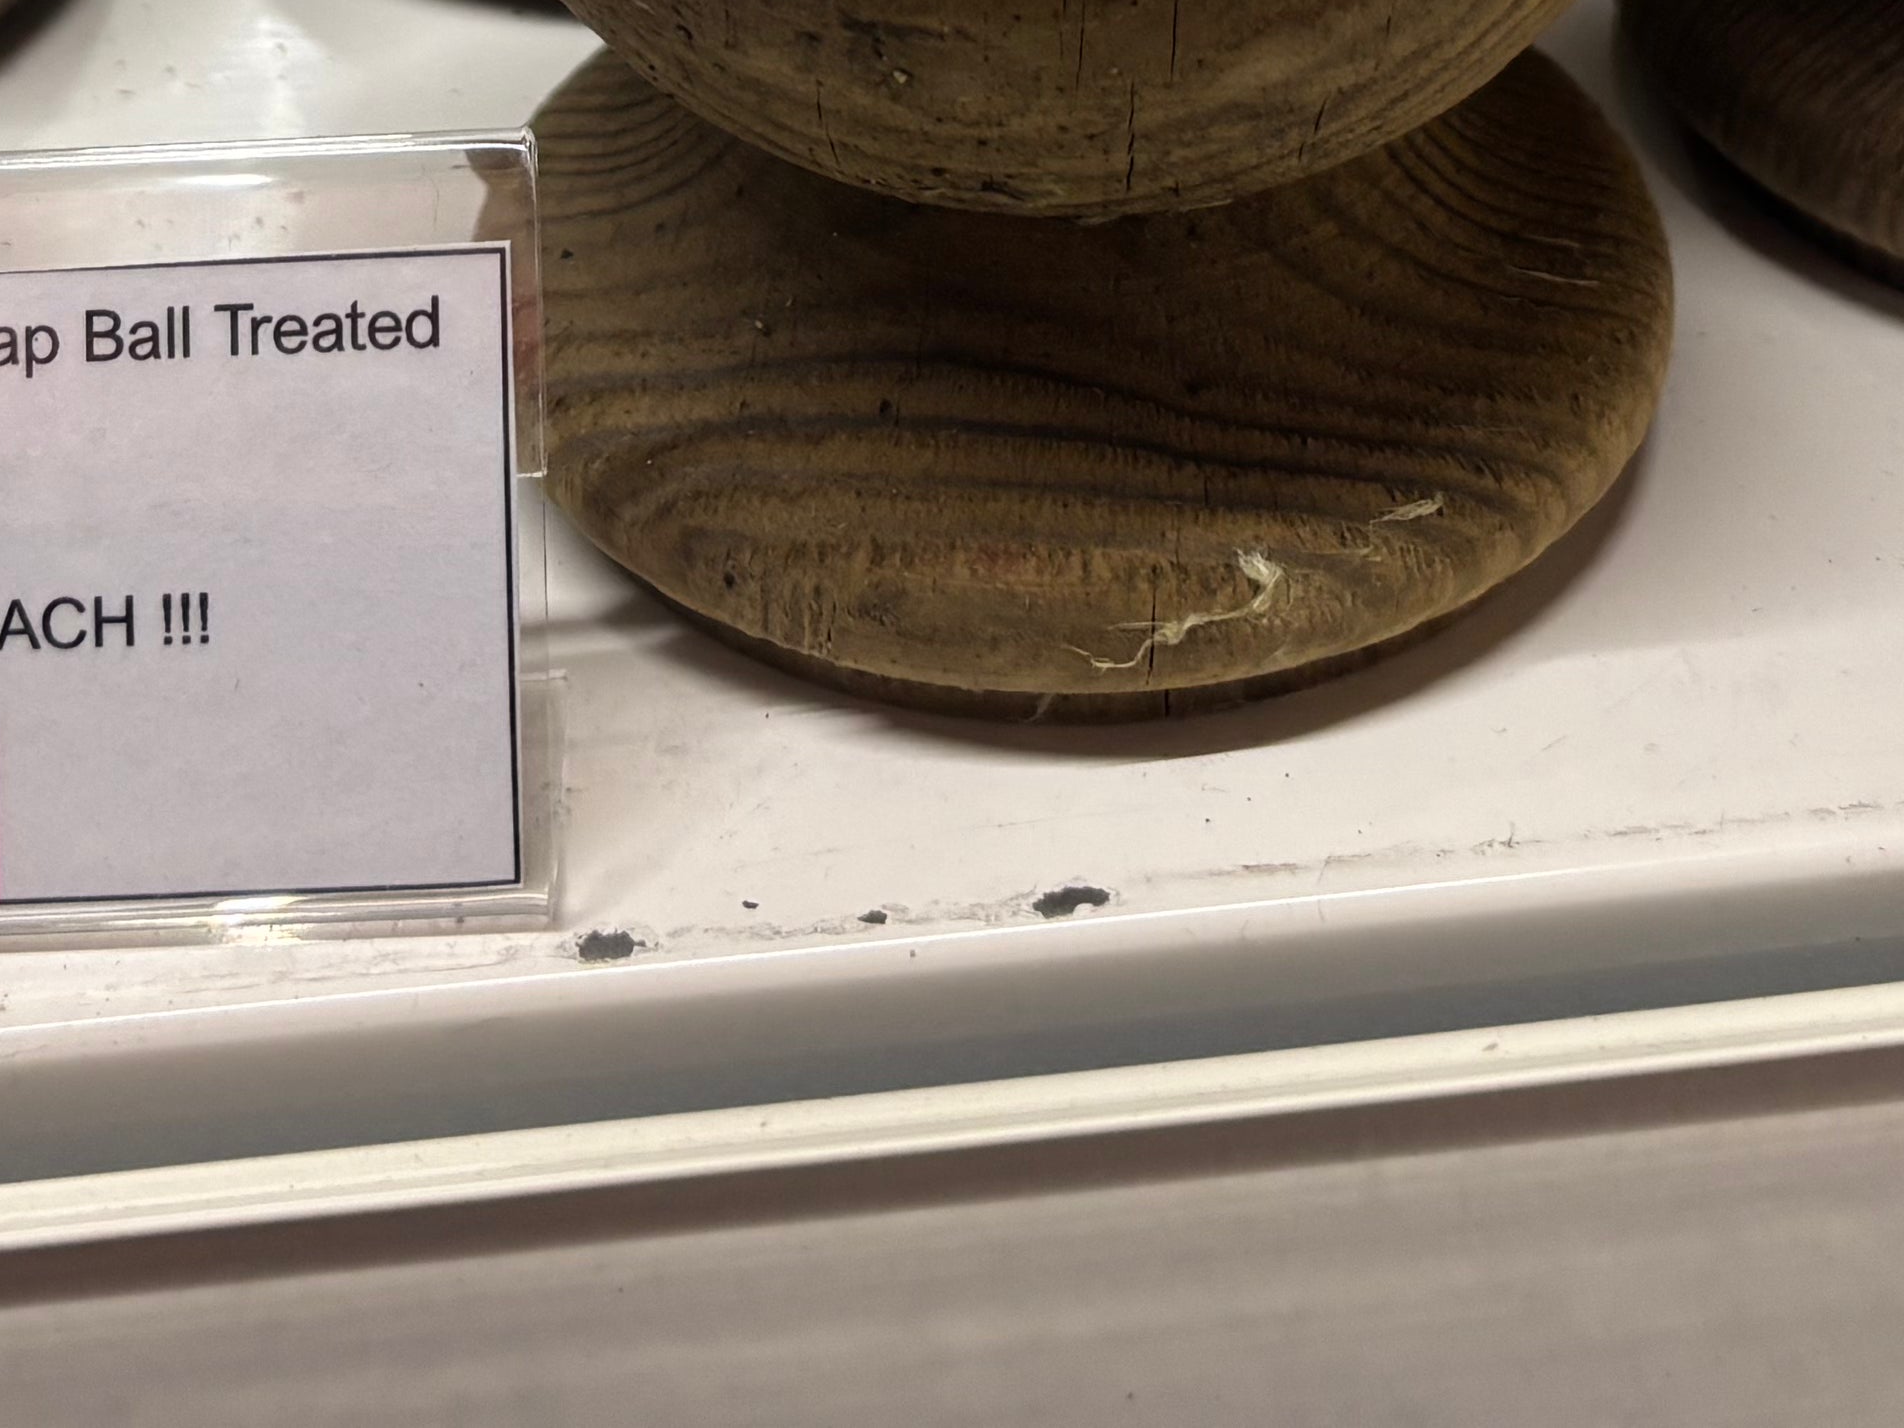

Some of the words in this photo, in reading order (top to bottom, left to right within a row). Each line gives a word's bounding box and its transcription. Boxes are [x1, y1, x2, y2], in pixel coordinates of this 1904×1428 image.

[83, 305, 192, 364] Ball
[216, 296, 441, 356] Treated
[161, 593, 209, 646] !!!
